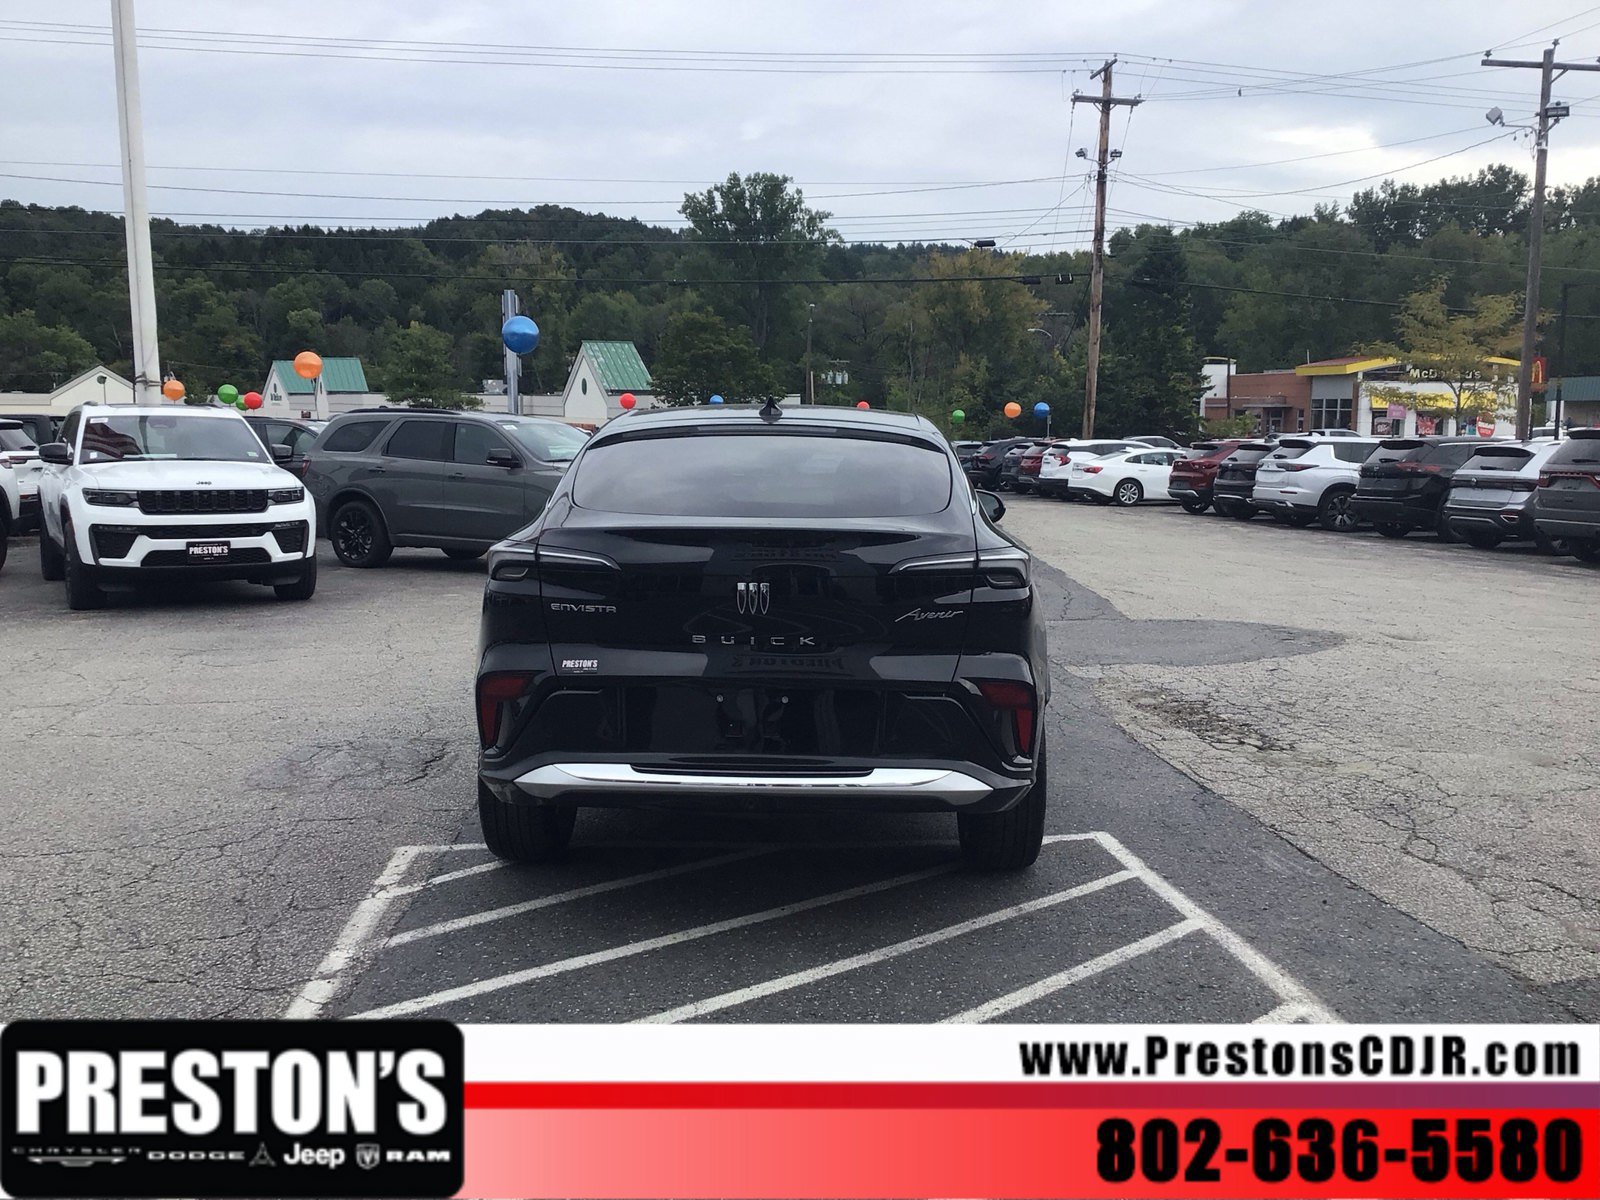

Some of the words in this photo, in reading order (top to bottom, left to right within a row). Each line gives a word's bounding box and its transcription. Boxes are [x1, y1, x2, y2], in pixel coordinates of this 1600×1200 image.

[189, 545, 229, 555] PRESTON'S
[691, 634, 816, 646] BUICK
[561, 659, 598, 668] PRESTON'S
